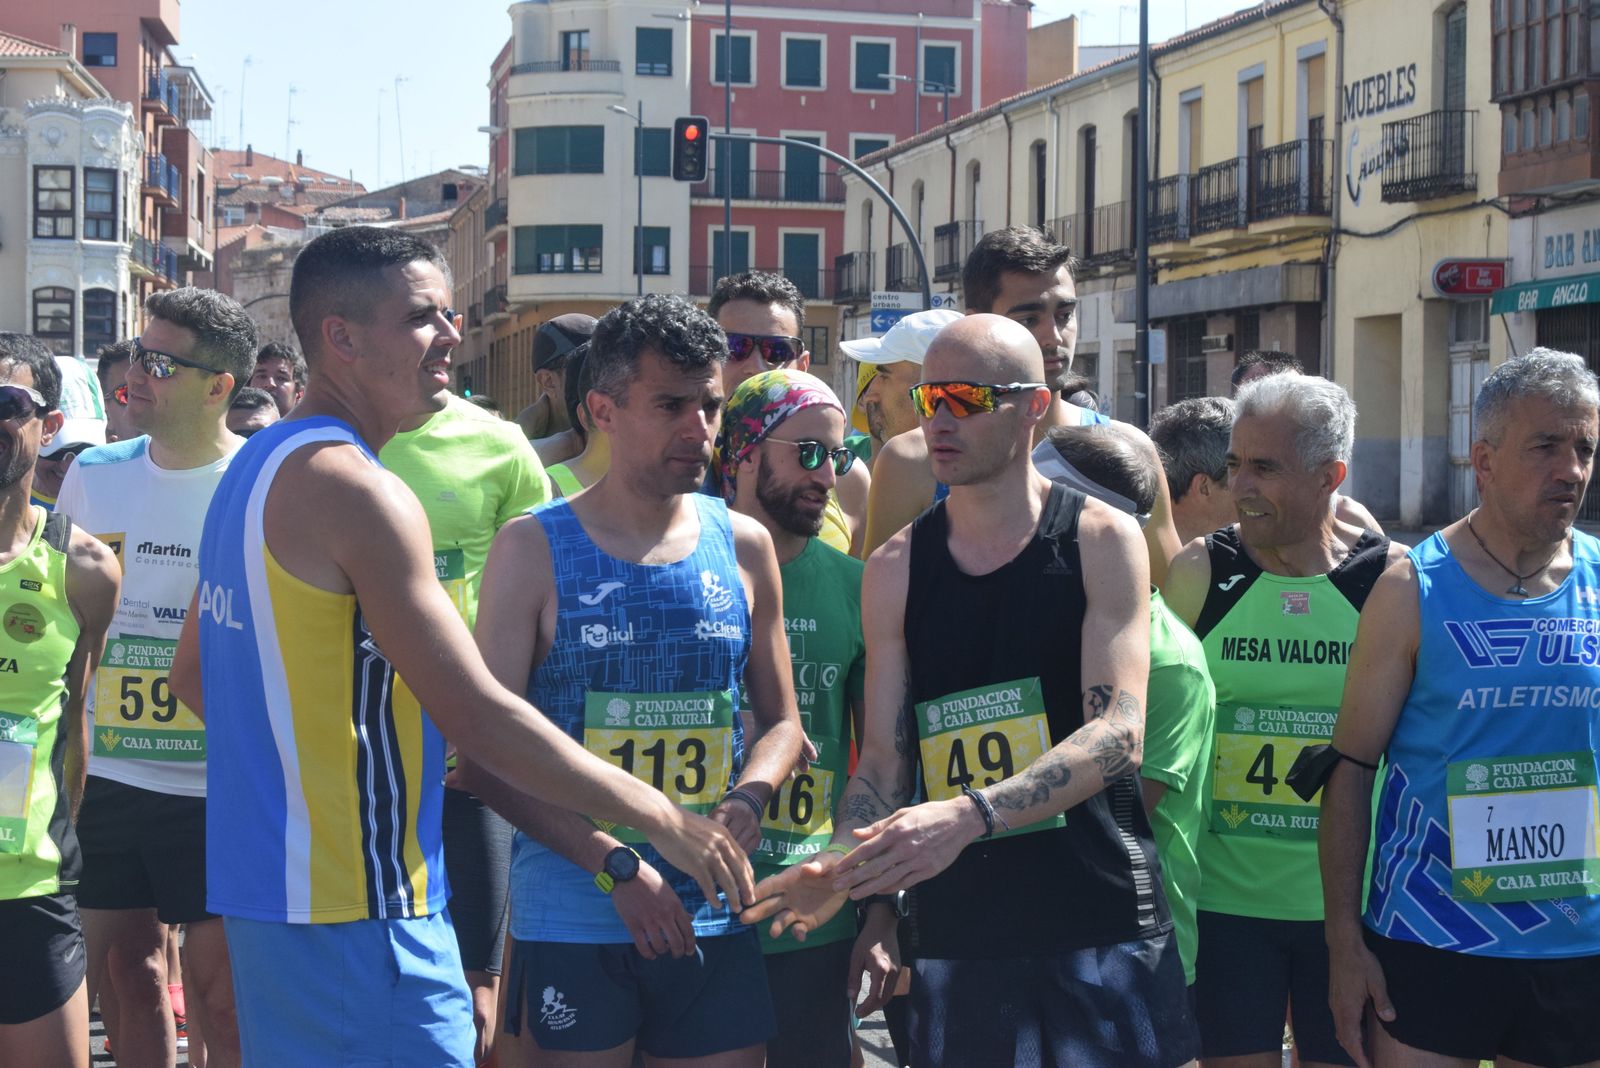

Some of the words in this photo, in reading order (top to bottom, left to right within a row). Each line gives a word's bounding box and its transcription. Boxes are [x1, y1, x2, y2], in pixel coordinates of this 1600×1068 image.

[1343, 63, 1416, 121] MUEBLES
[1545, 233, 1575, 268] BAR
[1518, 290, 1539, 310] BAR
[1552, 282, 1588, 306] ANGLO
[137, 542, 191, 558] Martín
[123, 597, 149, 609] Dental
[1221, 637, 1272, 662] MESA
[1538, 633, 1600, 667] ULS
[127, 656, 151, 667] CAJA
[120, 676, 178, 722] 59
[635, 699, 715, 713] FUNDACION
[942, 688, 1022, 715] FUNDACION
[635, 714, 668, 727] CAJA
[672, 713, 715, 726] RURAL
[944, 714, 974, 728] CAJA
[977, 702, 1024, 721] RURAL
[1259, 709, 1338, 724] FUNDACION
[1259, 722, 1288, 734] CAJA
[122, 737, 152, 749] CAJA
[156, 739, 202, 751] RURAL
[609, 738, 706, 794] 113
[947, 732, 1014, 790] 49
[1493, 759, 1576, 776] FUNDACION
[1493, 775, 1527, 789] CAJA
[1531, 772, 1576, 786] RURAL
[1250, 813, 1286, 828] CAJA
[1487, 806, 1494, 823] 7
[1486, 823, 1565, 862] MANSO
[1497, 874, 1536, 890] CAJA
[1539, 871, 1593, 886] RURAL
